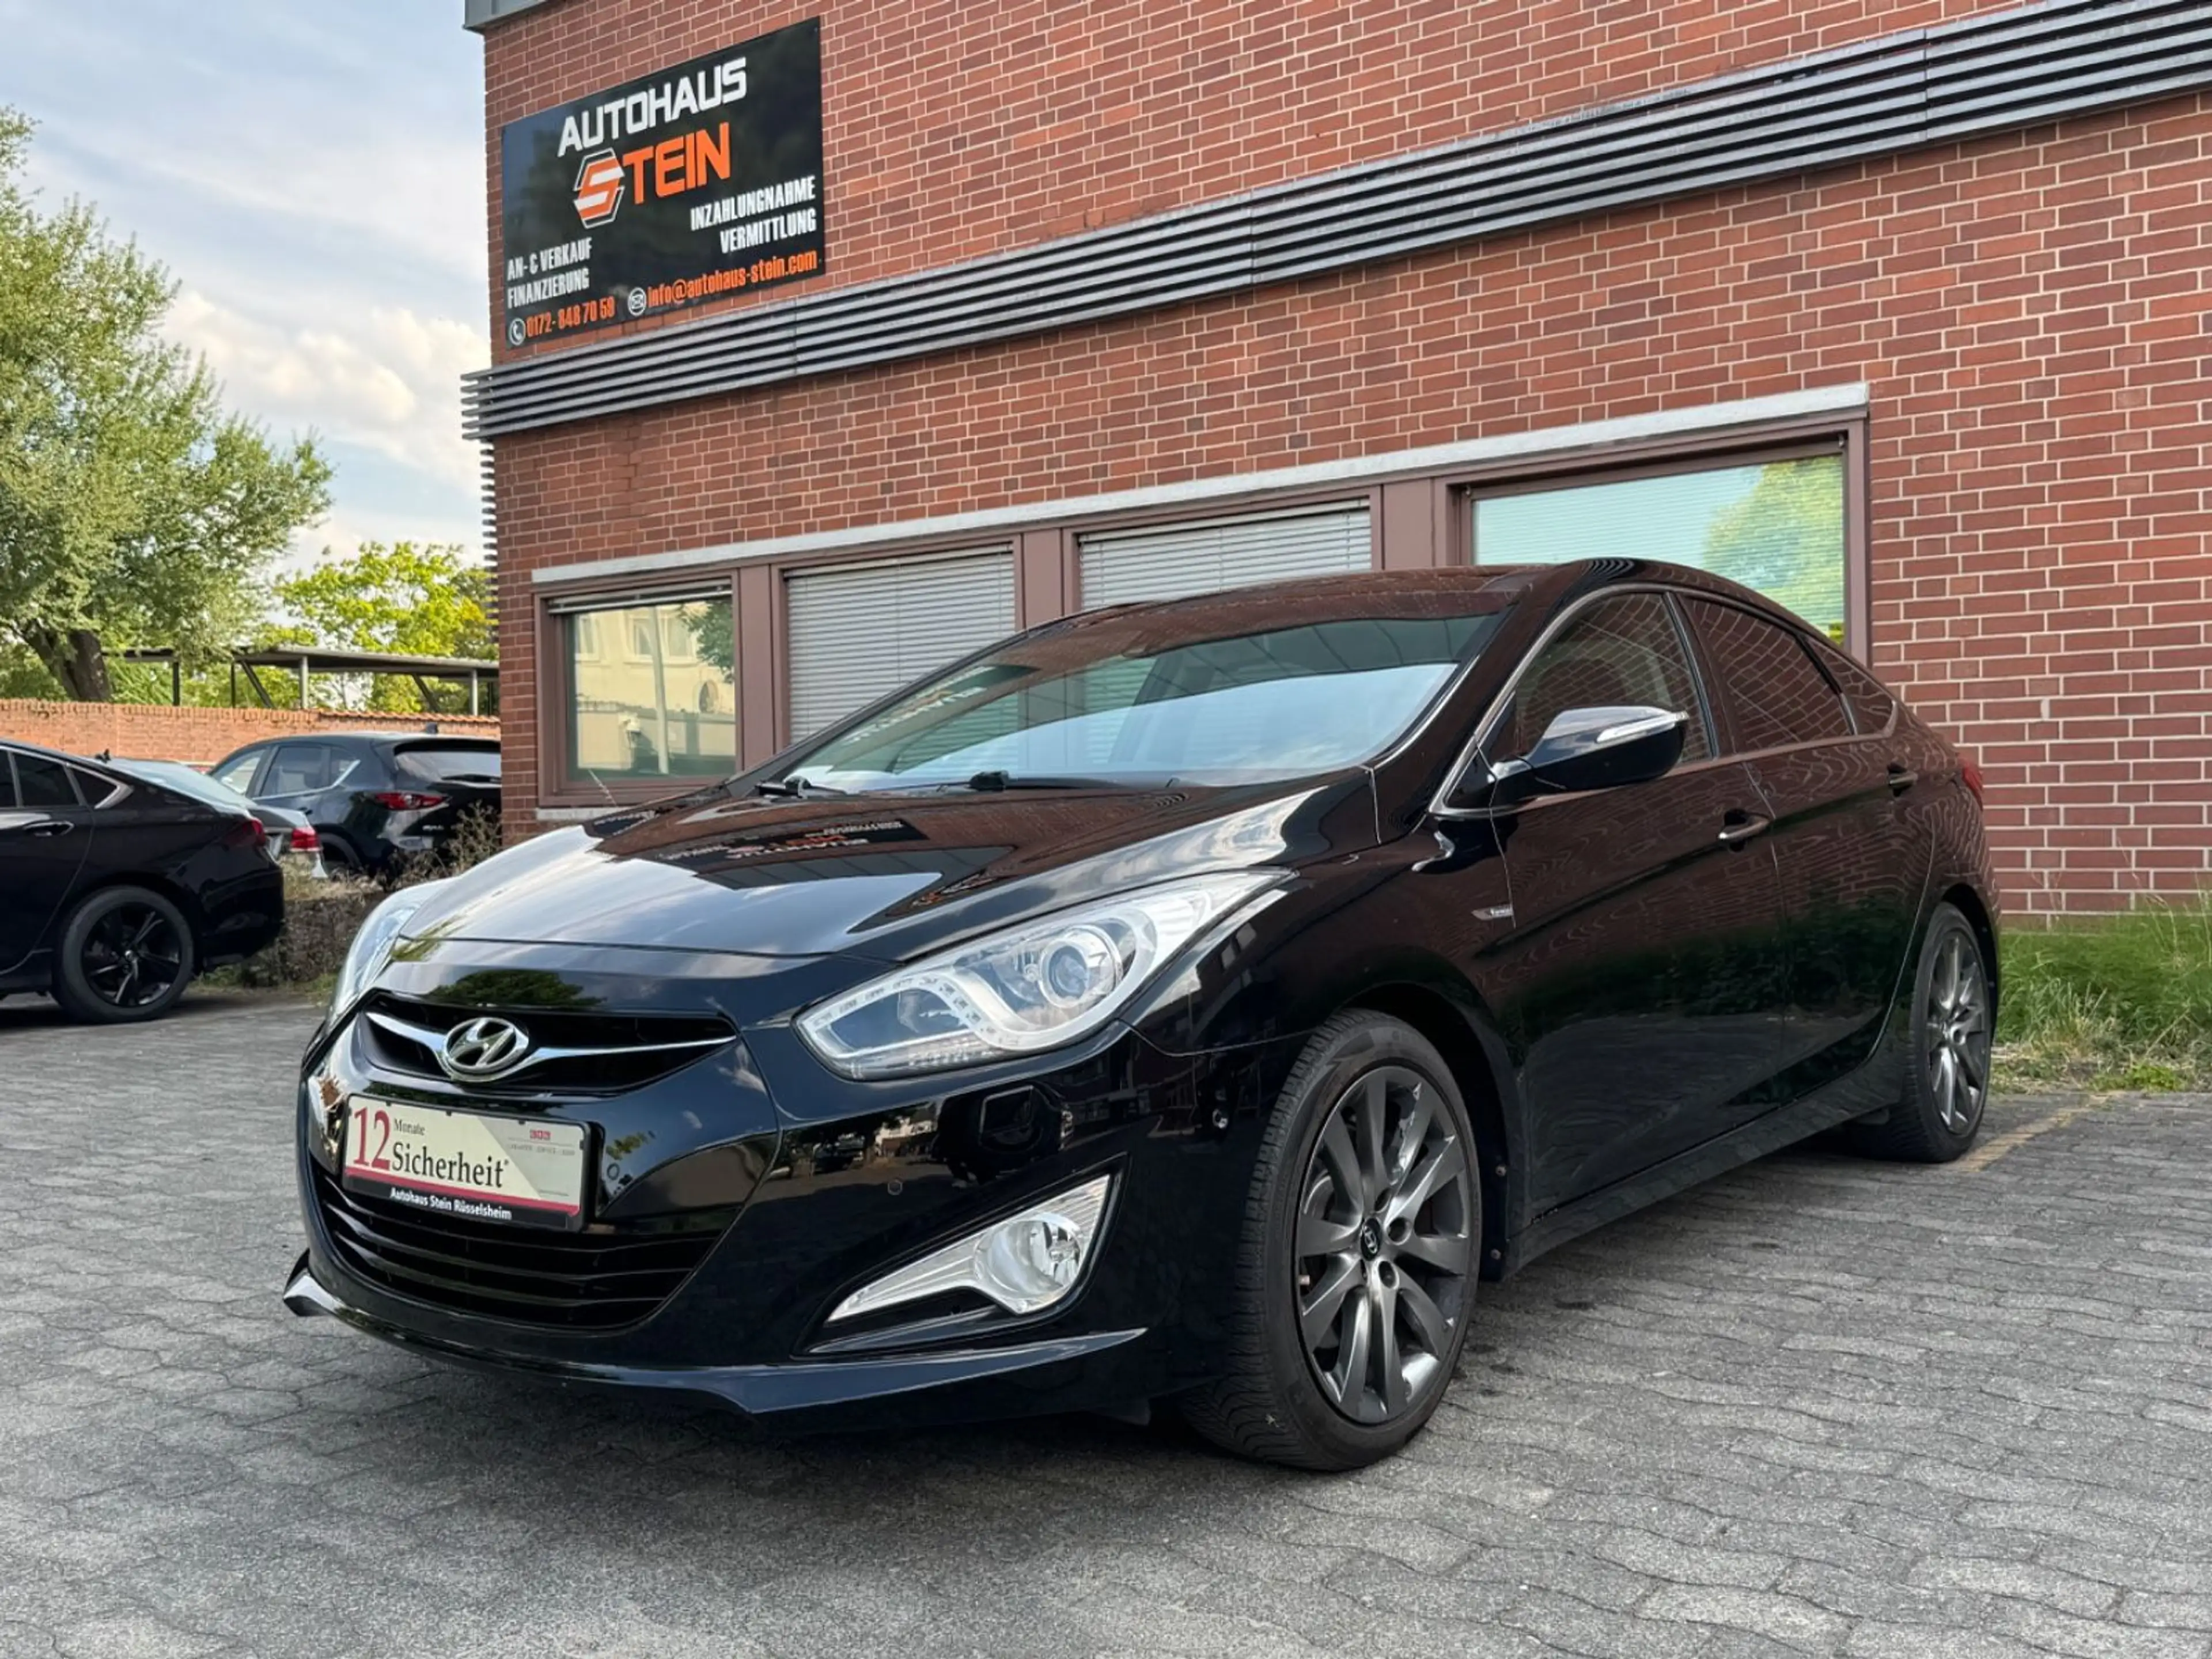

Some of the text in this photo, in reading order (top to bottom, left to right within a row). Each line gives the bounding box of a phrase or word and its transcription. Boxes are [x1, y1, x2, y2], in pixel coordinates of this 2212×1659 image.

[558, 57, 747, 157] AUTOHAUS
[573, 122, 730, 229] STEIN
[690, 175, 816, 232] INZAHLUNGNAHME
[540, 237, 593, 271] VERKAUF
[719, 207, 817, 253] VERMITTLUNG
[507, 267, 590, 309] FINANZIERUNG
[647, 250, 818, 307] info@autohaus-stein.com
[353, 1107, 391, 1171] 12
[393, 1118, 426, 1135] Monate
[389, 1187, 512, 1220] Autohaus Stein Rüsselsheim
